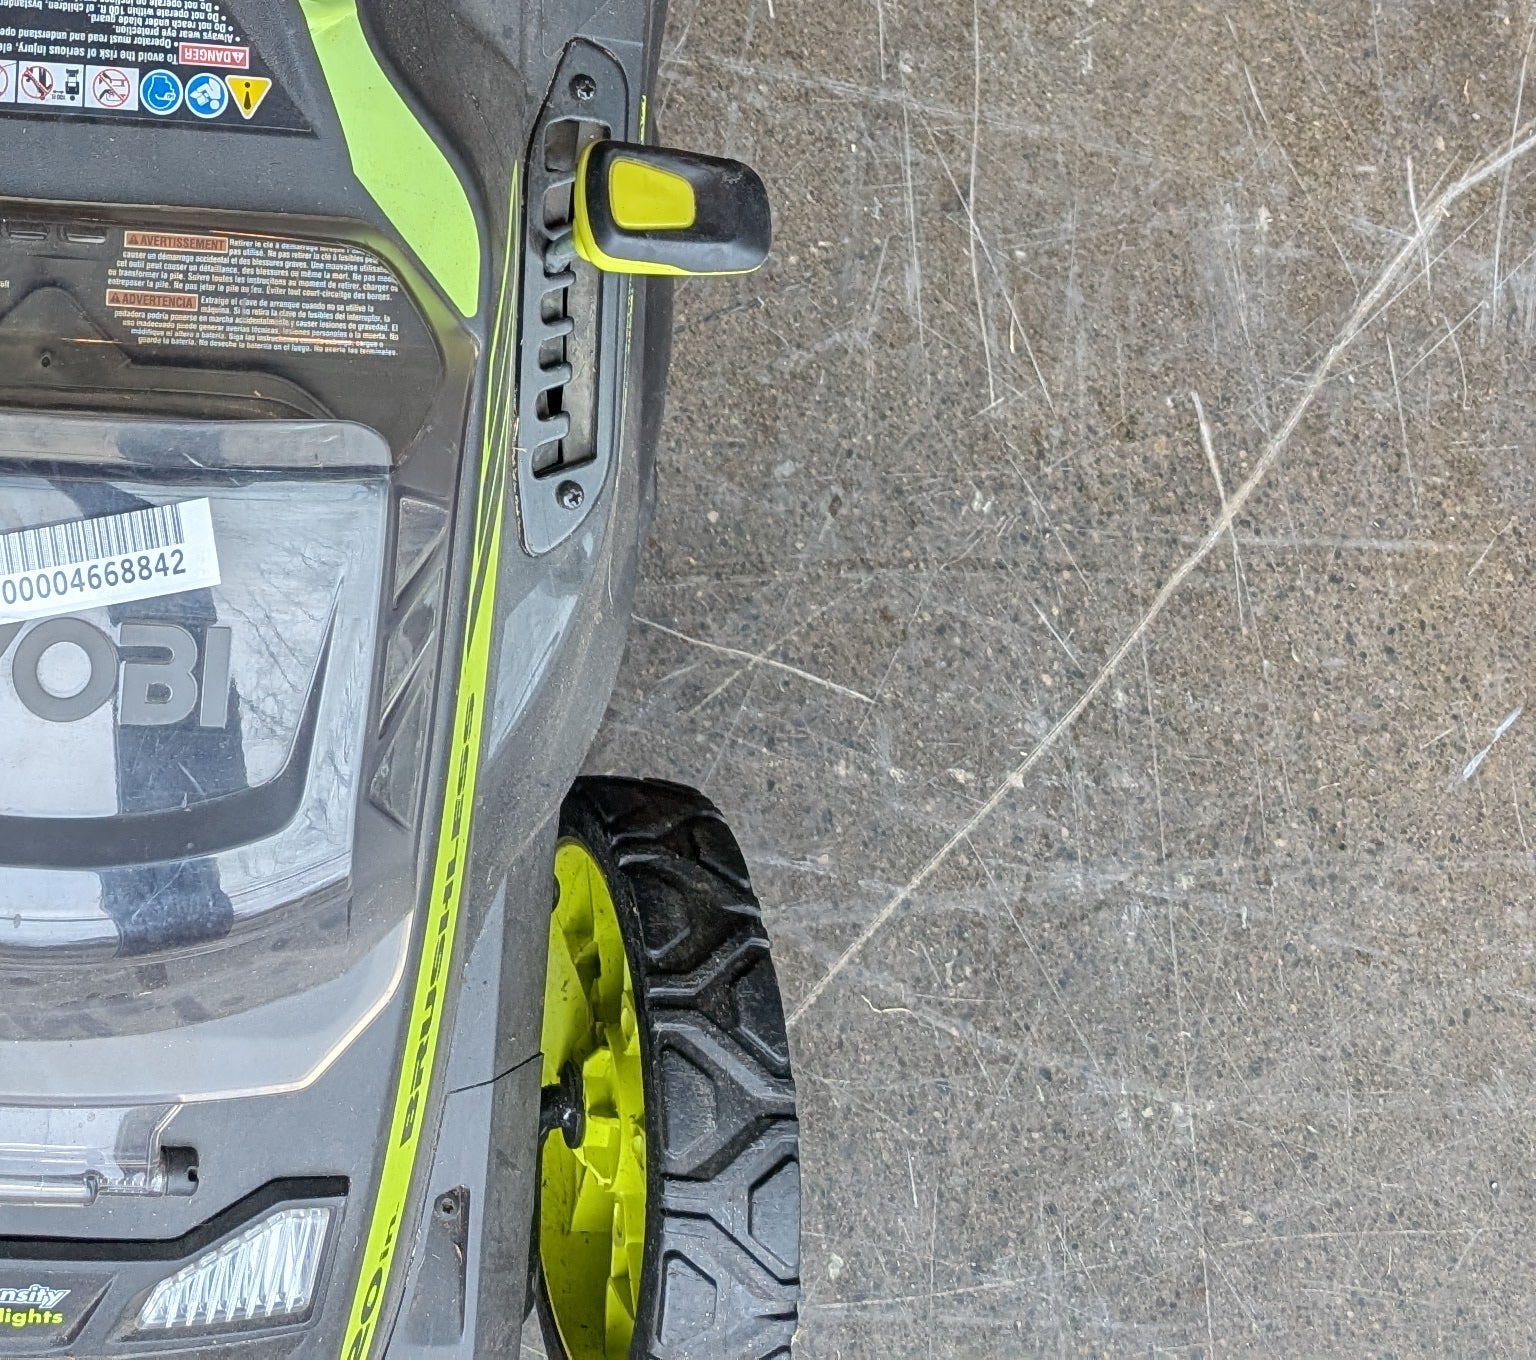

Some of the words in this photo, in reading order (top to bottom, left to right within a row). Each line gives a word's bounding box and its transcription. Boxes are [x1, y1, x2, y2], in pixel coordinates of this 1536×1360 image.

[43, 0, 83, 12] children,
[85, 4, 94, 12] of
[97, 5, 106, 13] ft.
[183, 0, 197, 9] not
[199, 1, 211, 10] Do
[108, 5, 123, 14] 100
[126, 7, 154, 16] within
[155, 7, 189, 19] operate
[87, 12, 115, 24] guard.
[190, 11, 204, 20] not
[206, 12, 218, 21] Do
[117, 16, 142, 25] blade
[144, 18, 169, 27] under
[171, 20, 195, 29] reach
[112, 23, 159, 37] protection.
[197, 21, 211, 30] not
[213, 22, 226, 31] Do
[18, 29, 66, 40] understand
[161, 27, 176, 36] eye
[178, 30, 200, 38] wear
[202, 30, 233, 42] Always
[69, 32, 85, 41] and
[87, 34, 107, 43] read
[109, 35, 131, 44] must
[133, 35, 171, 47] Operator
[15, 42, 46, 55] injury,
[48, 46, 84, 57] serious
[86, 48, 96, 58] of
[99, 49, 117, 59] risk
[119, 50, 135, 61] the
[137, 51, 164, 62] avoid
[166, 53, 178, 63] To
[184, 48, 231, 62] DANGER
[142, 234, 224, 250] AVERTISSEMENT
[122, 292, 193, 308] ADVERTENCIA
[401, 692, 476, 1149] BRUSHLESS
